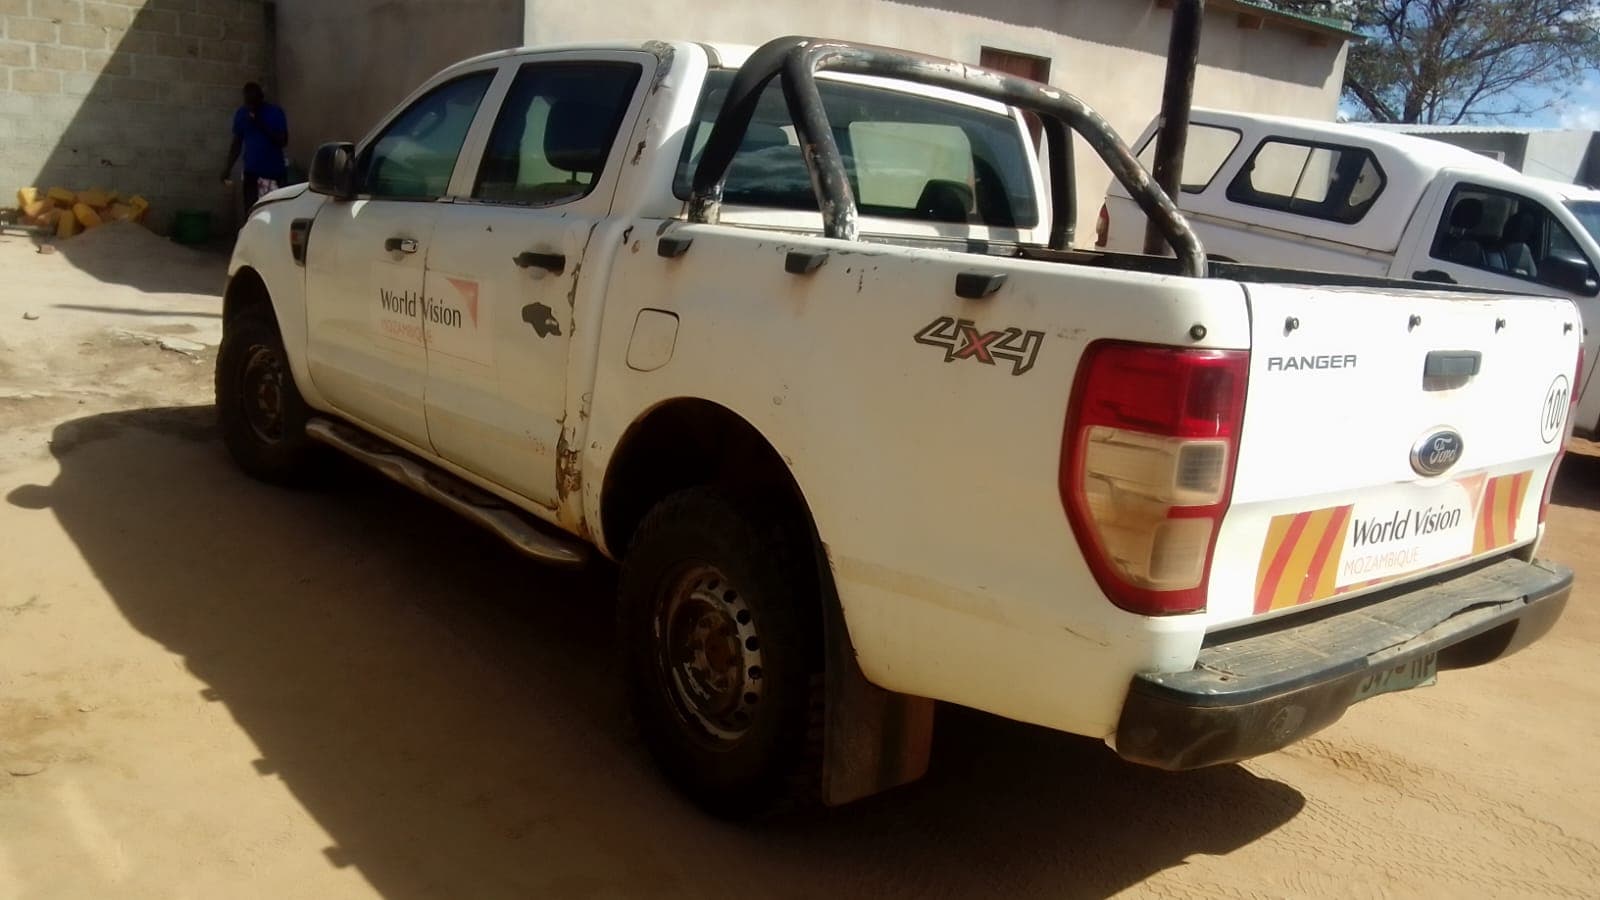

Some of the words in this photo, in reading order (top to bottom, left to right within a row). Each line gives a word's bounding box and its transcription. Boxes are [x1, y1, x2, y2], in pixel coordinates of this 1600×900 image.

[380, 287, 417, 318] World
[420, 295, 462, 328] Vision
[1267, 354, 1357, 371] RANGER
[1545, 388, 1567, 430] 100
[1429, 437, 1456, 465] Ford
[1352, 509, 1411, 548] World
[1414, 504, 1461, 537] Vision
[1343, 546, 1420, 576] MOZAMBIQUE
